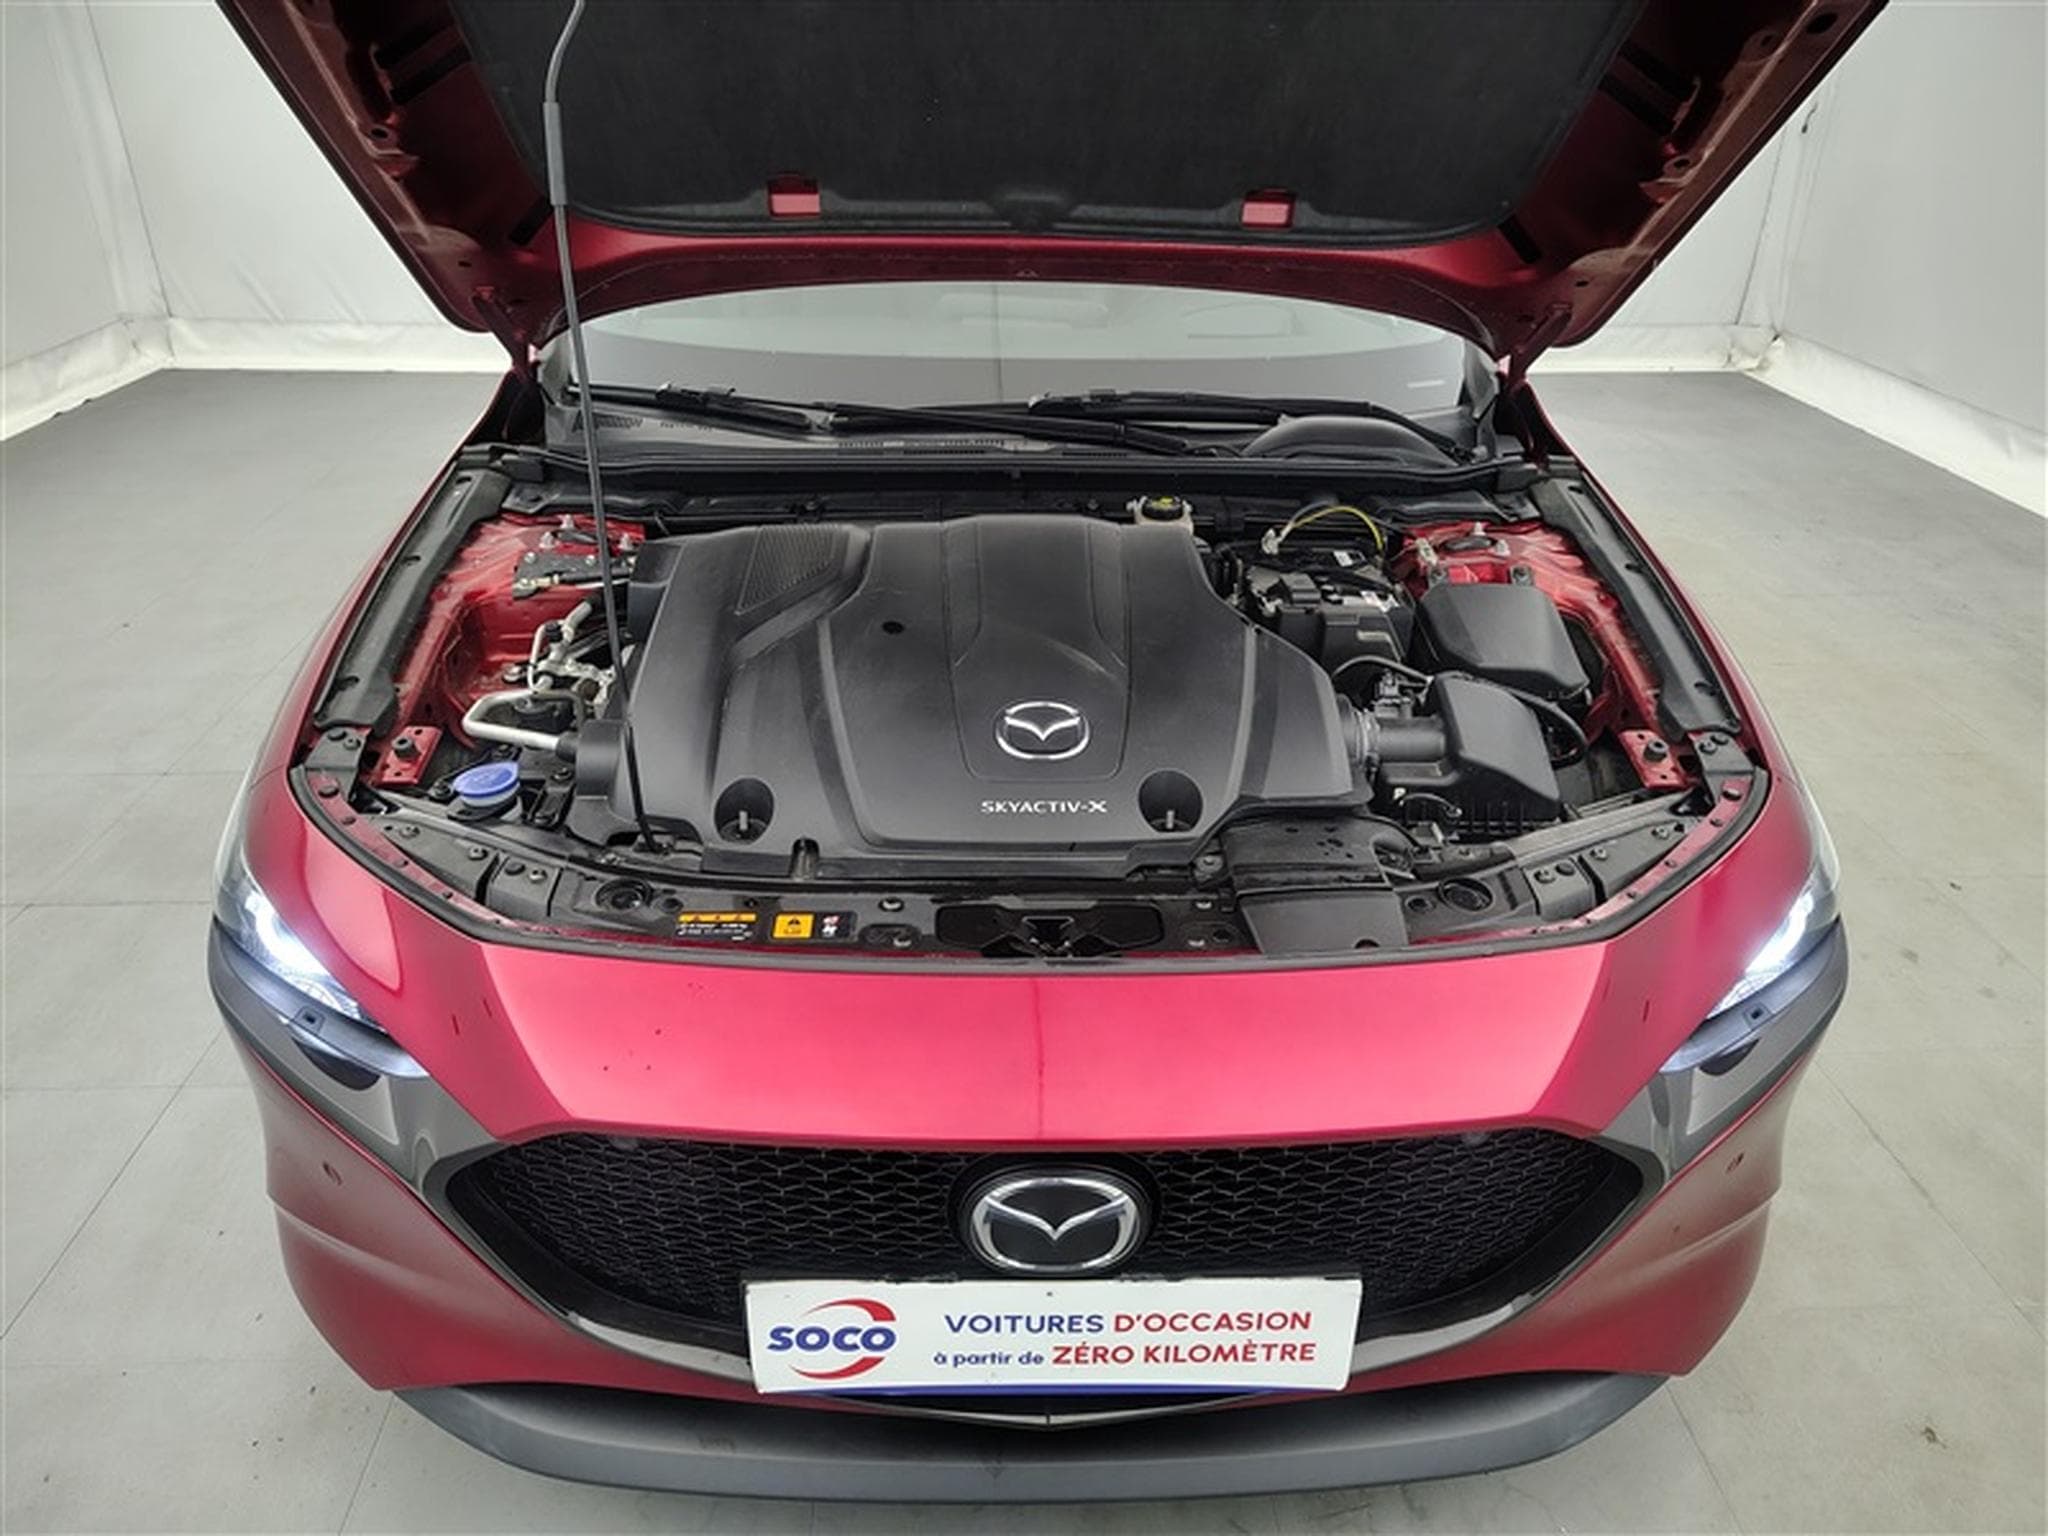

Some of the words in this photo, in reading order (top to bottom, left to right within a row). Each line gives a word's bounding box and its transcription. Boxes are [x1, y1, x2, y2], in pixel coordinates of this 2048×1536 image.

[980, 799, 1108, 814] SKYACTIV-X
[944, 1314, 1104, 1334] VOITURES
[1113, 1311, 1312, 1333] D'OCCASION
[766, 1326, 897, 1352] SOCO
[933, 1351, 948, 1365] à
[952, 1351, 1012, 1369] partir
[1017, 1351, 1045, 1365] de
[1052, 1341, 1135, 1365] ZÉRO
[1143, 1339, 1317, 1364] KILOMÈTRE
